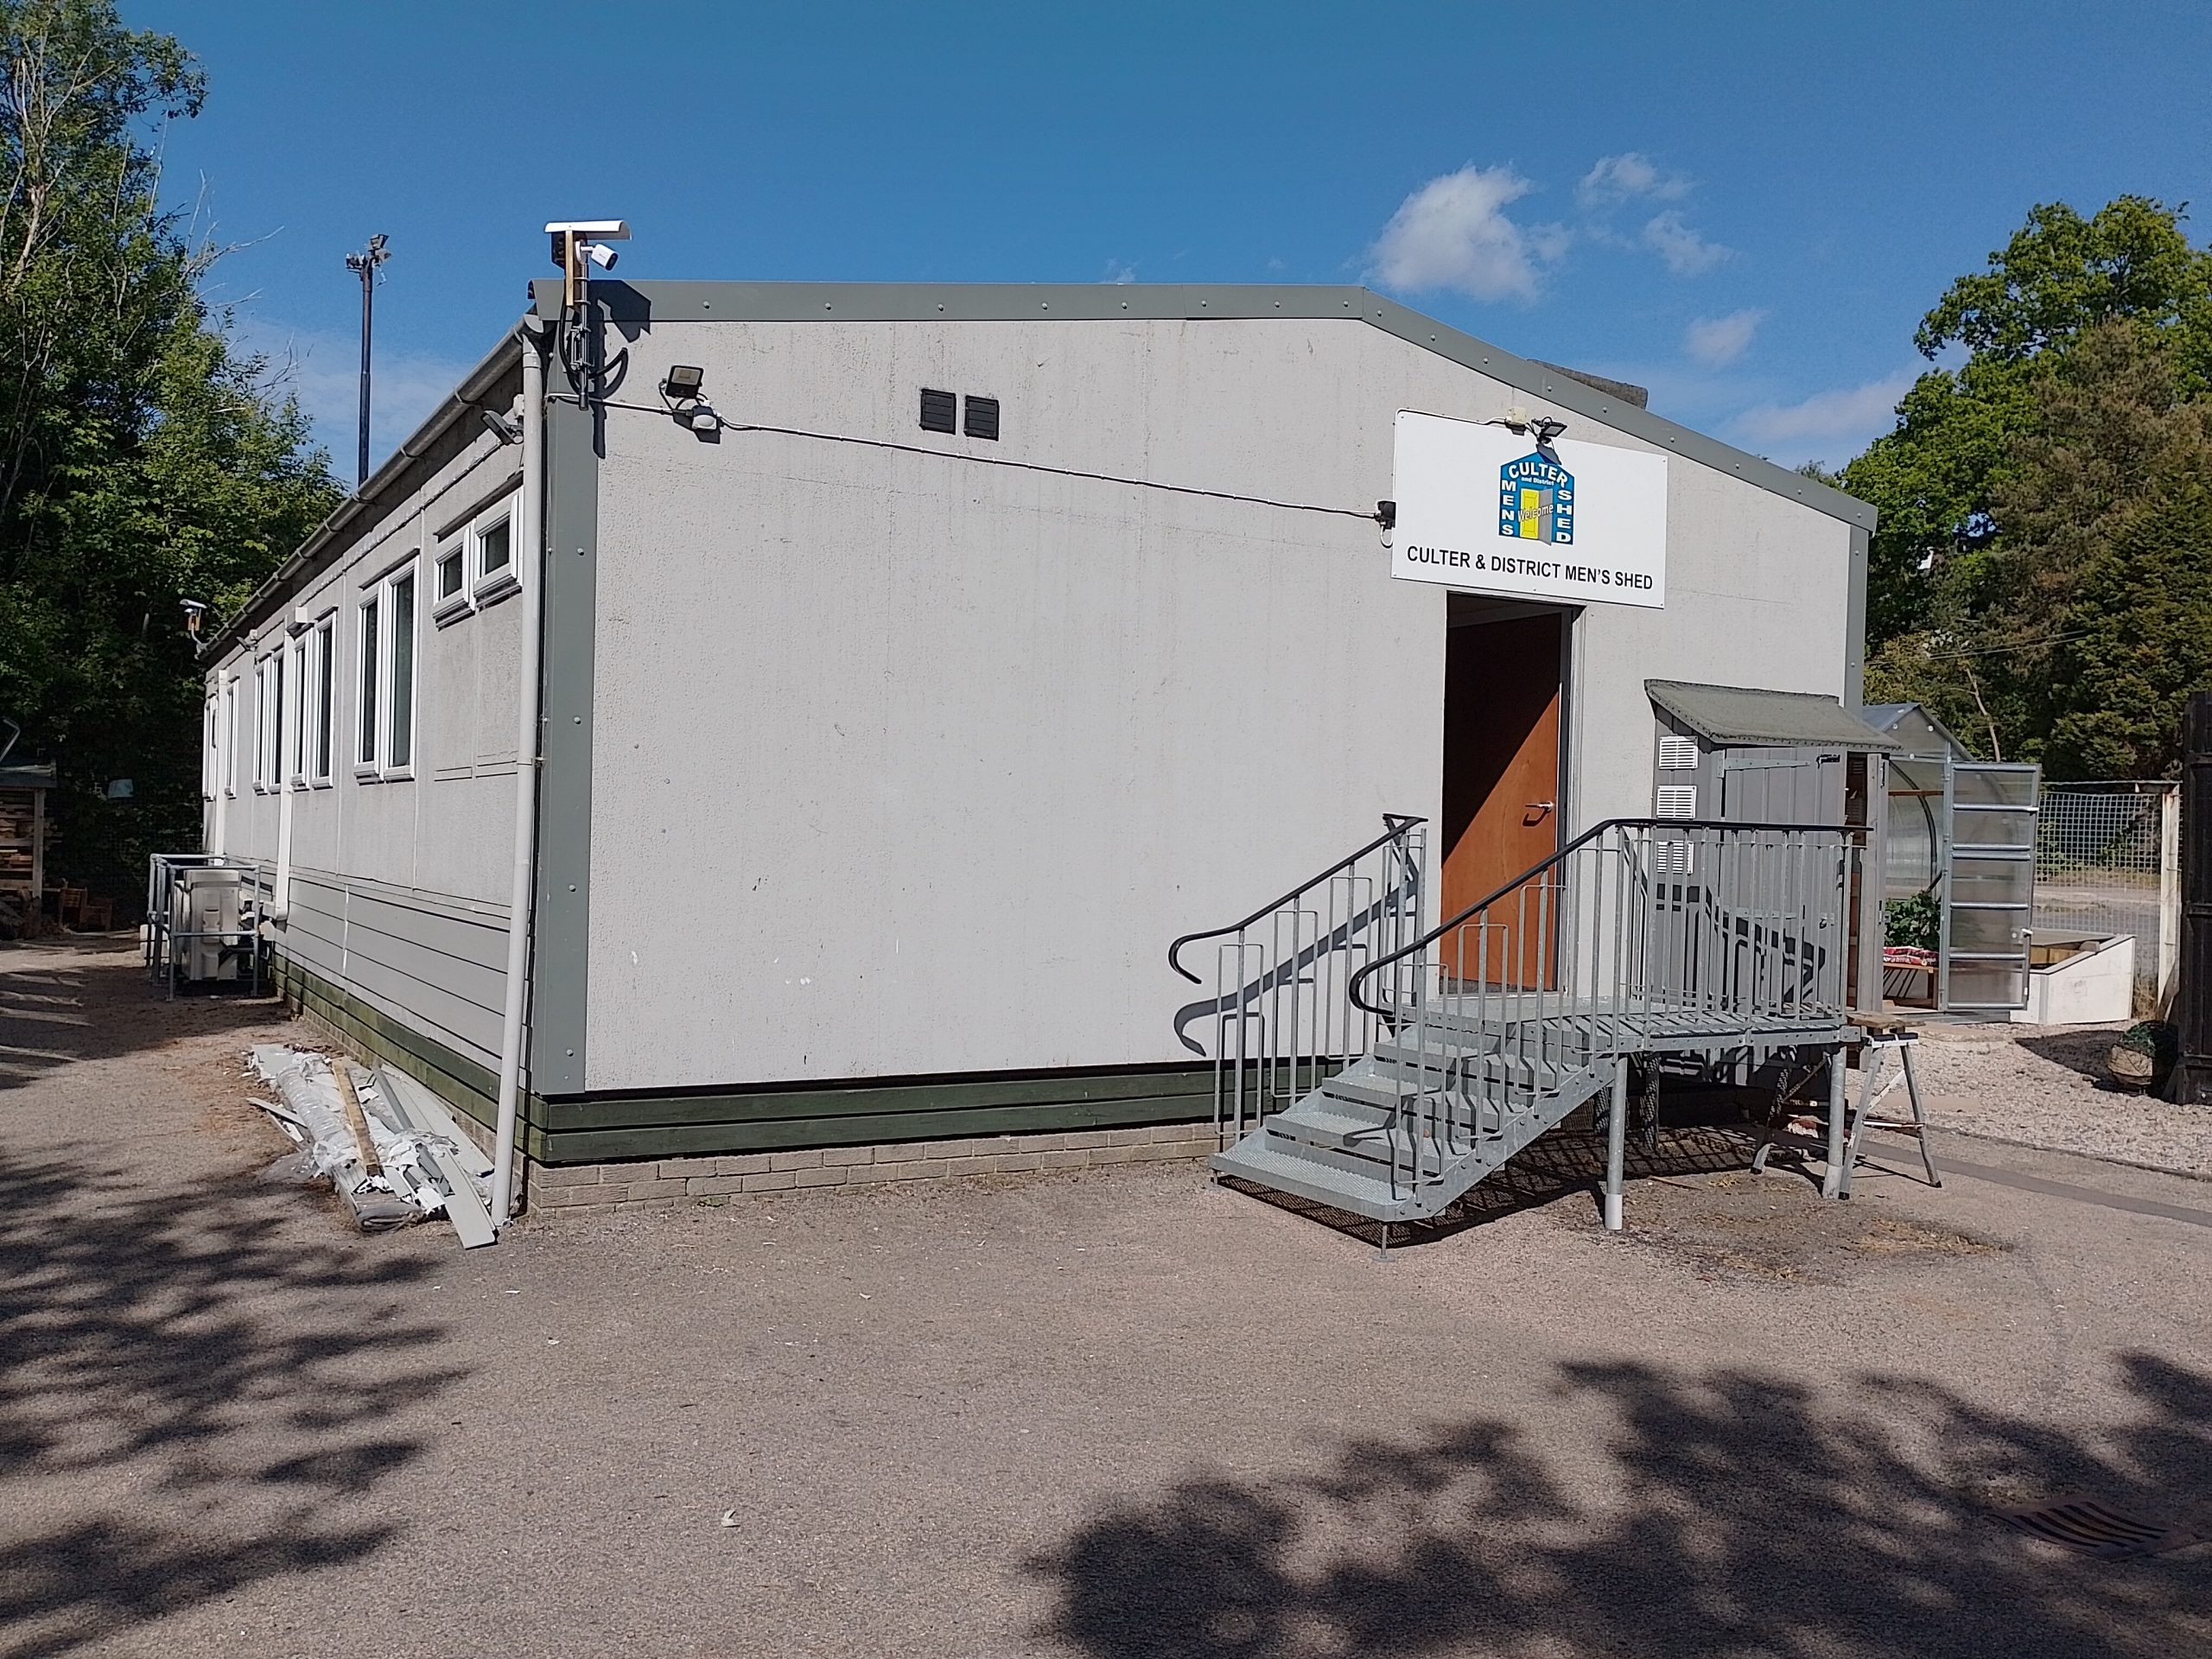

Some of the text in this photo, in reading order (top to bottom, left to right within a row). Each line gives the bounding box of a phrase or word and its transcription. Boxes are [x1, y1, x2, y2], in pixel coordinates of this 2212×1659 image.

[1509, 462, 1568, 488] CULTER
[1533, 478, 1554, 486] District
[1501, 480, 1516, 536] MENS
[1517, 504, 1554, 523] Welcome
[1556, 490, 1573, 543] SHED
[1407, 545, 1653, 589] CULTER & DISTRICT MEN'S SHED
